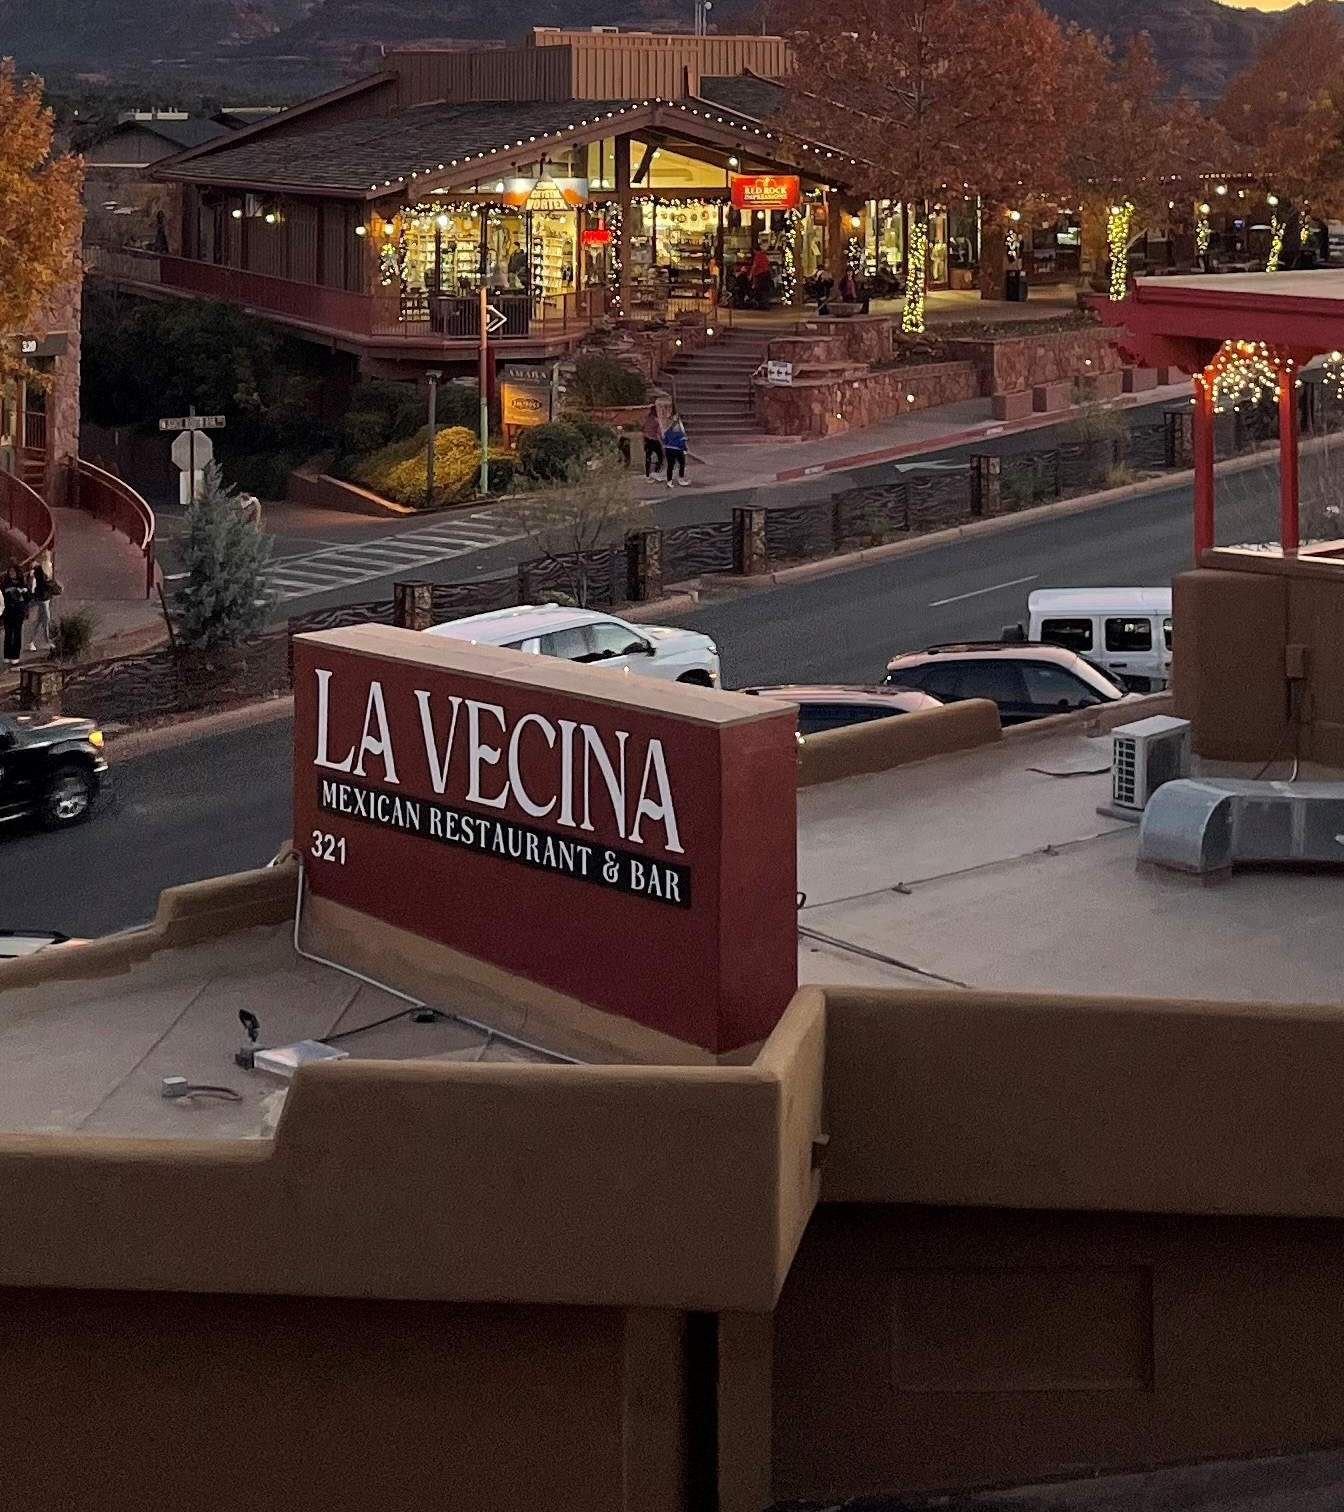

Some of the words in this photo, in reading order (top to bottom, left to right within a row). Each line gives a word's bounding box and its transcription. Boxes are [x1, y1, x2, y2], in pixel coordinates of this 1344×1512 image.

[525, 198, 568, 211] VORTEX
[744, 186, 762, 195] RED
[763, 186, 787, 195] ROCK
[314, 668, 400, 784] LA
[414, 689, 685, 854] VECINA
[311, 829, 347, 866] 321
[322, 779, 422, 830] MEXICAN
[429, 806, 592, 876] RESTAURANT
[602, 850, 620, 884] &
[630, 859, 681, 903] BAR
